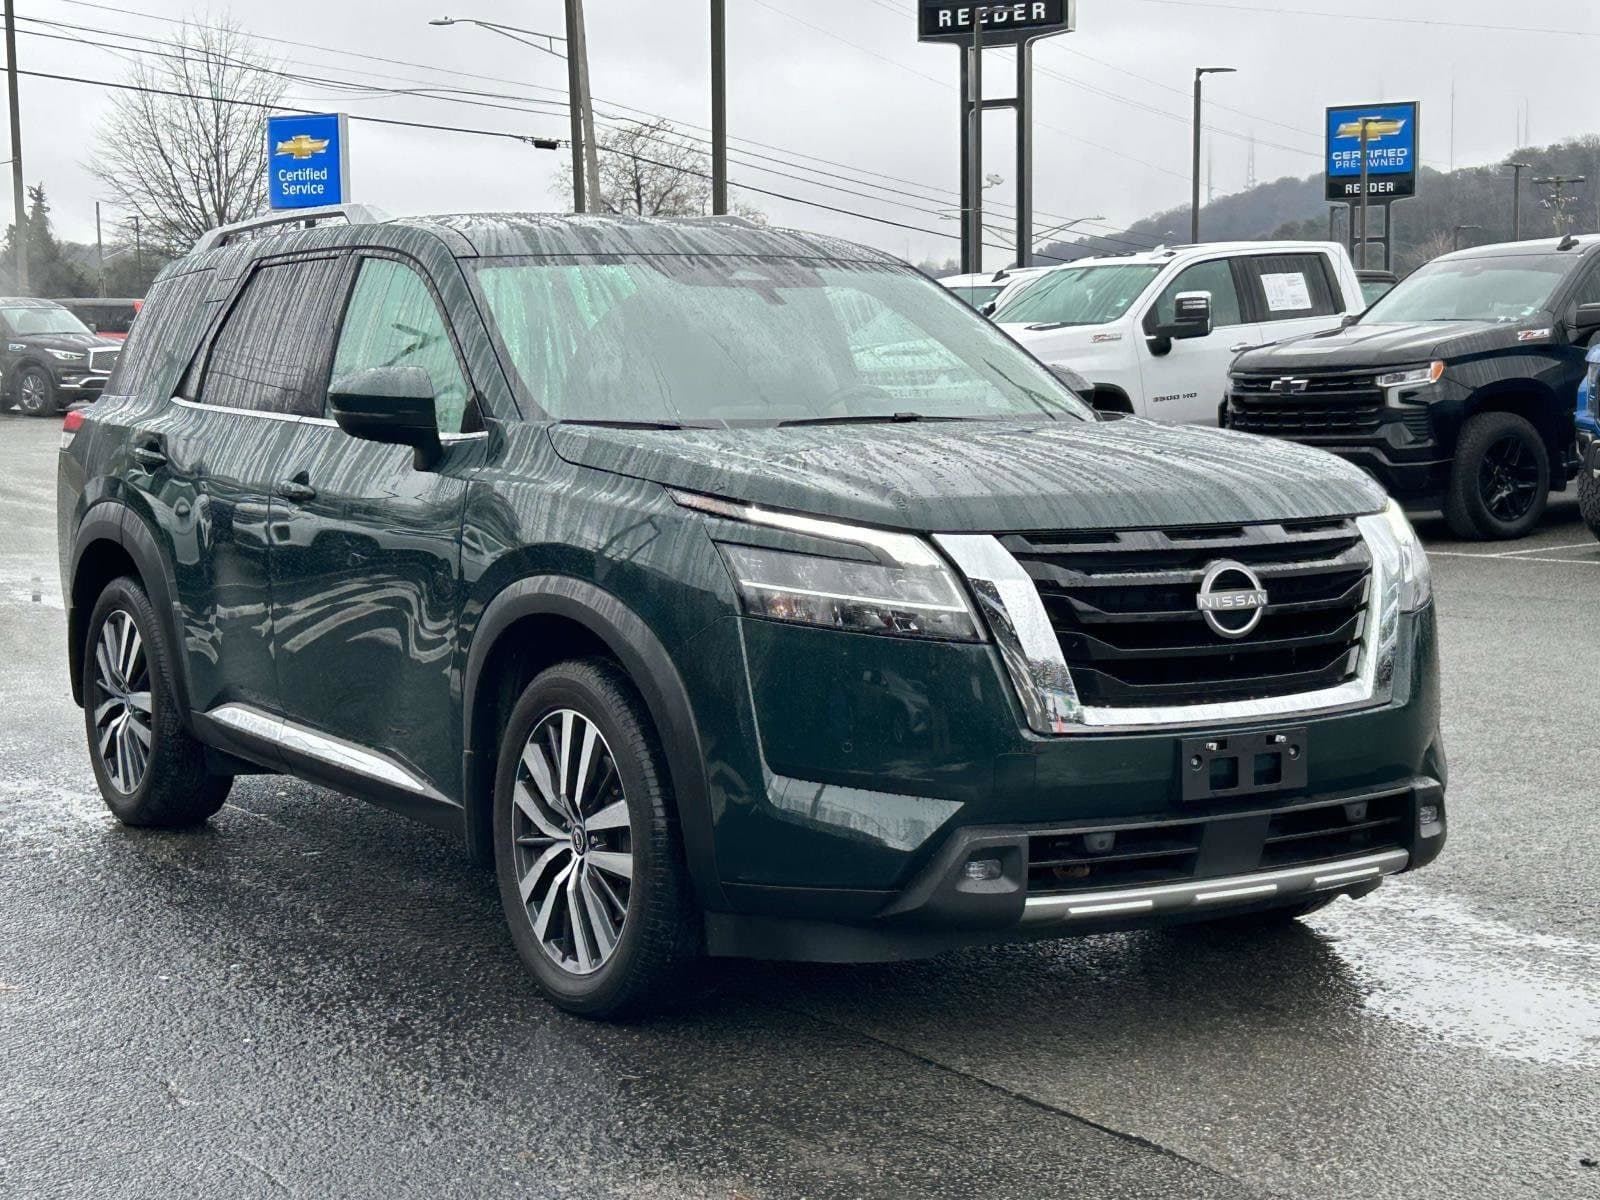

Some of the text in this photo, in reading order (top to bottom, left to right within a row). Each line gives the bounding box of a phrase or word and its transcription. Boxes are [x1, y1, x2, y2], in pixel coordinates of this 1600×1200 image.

[1332, 148, 1408, 160] CERIFIED
[1335, 157, 1404, 169] PRE-WNED
[278, 167, 328, 181] Certified
[282, 182, 325, 195] Service
[1345, 181, 1394, 194] REDER
[1199, 594, 1267, 608] NISSAN
